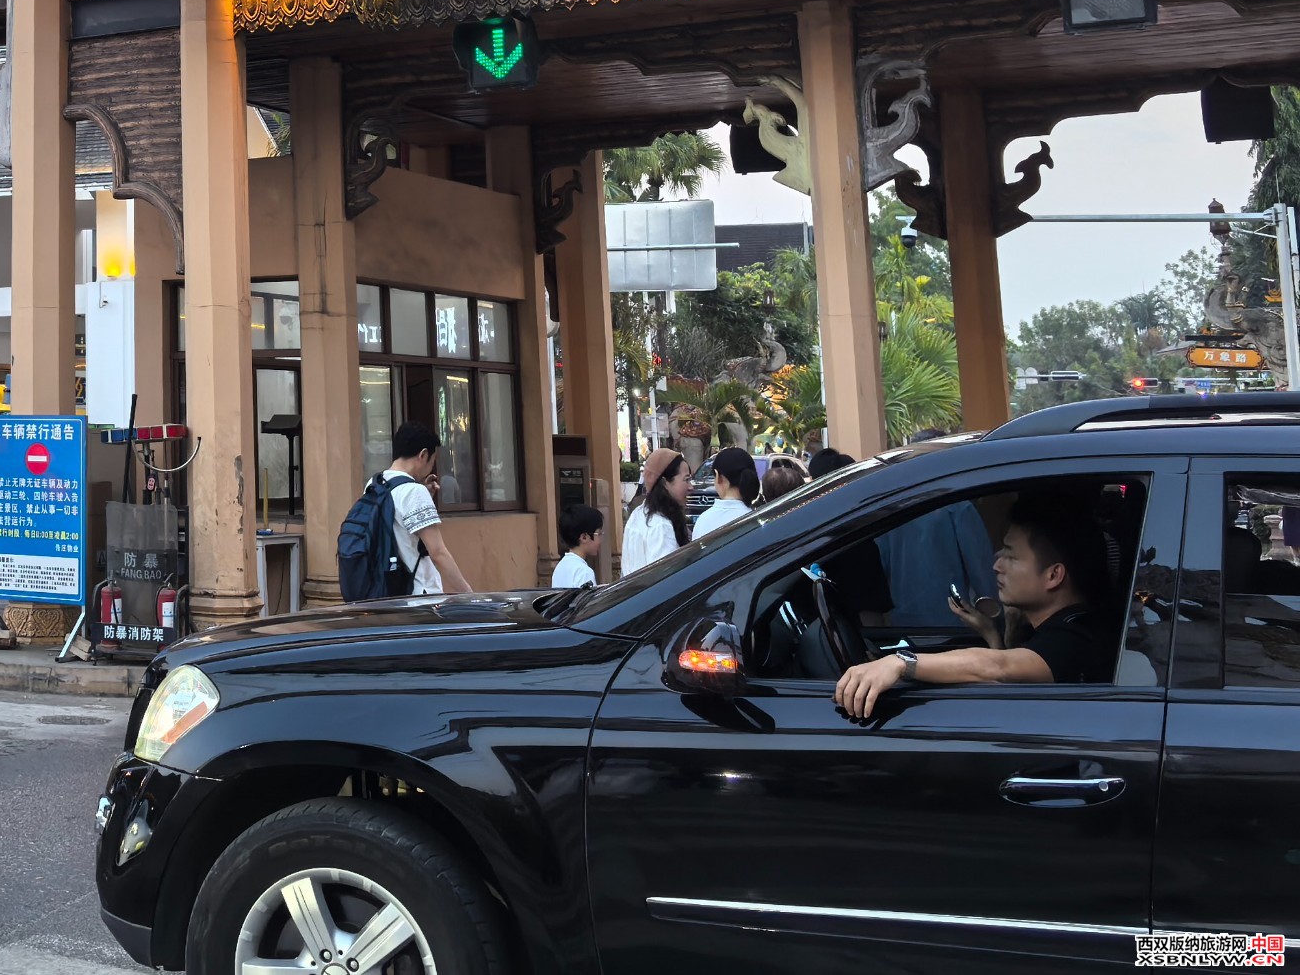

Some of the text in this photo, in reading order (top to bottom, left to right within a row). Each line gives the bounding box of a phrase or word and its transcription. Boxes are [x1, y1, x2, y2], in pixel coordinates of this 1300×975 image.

[1204, 351, 1246, 363] 万象路
[1, 423, 75, 441] 车辆禁行通告
[124, 552, 159, 568] 防暴
[120, 567, 162, 580] FANG BAO
[104, 625, 164, 642] 防暴消防架
